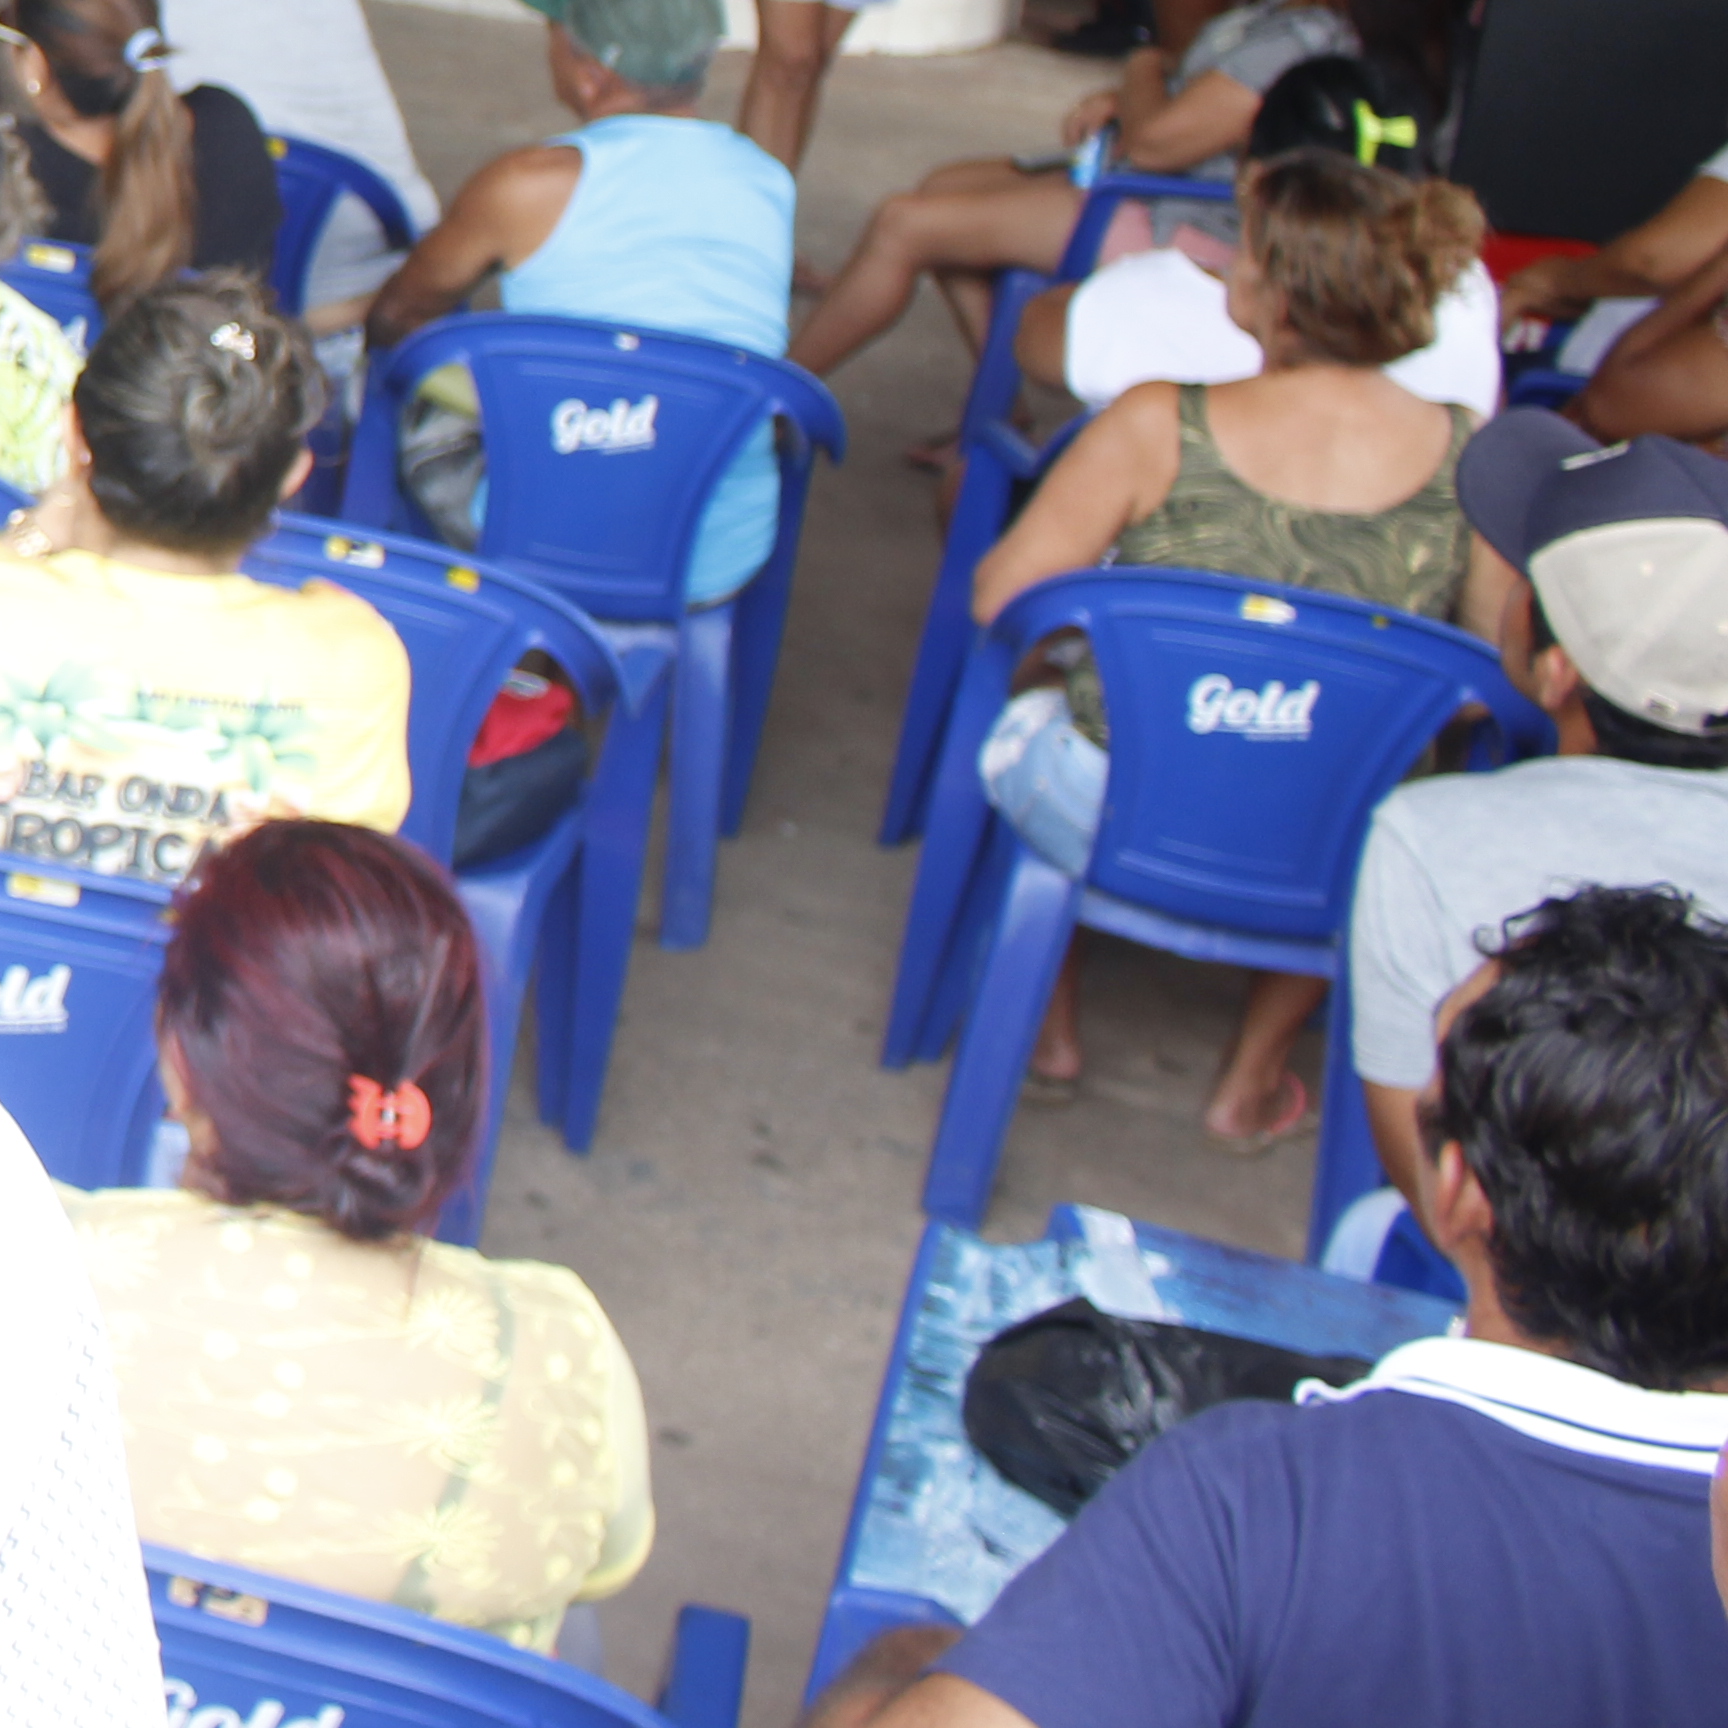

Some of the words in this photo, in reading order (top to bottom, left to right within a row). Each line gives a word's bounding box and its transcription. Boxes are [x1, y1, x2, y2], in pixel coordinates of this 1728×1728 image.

[550, 393, 659, 455] Gold
[1186, 672, 1321, 735] Gold
[22, 759, 105, 805] BAR
[117, 775, 231, 826] ONDA
